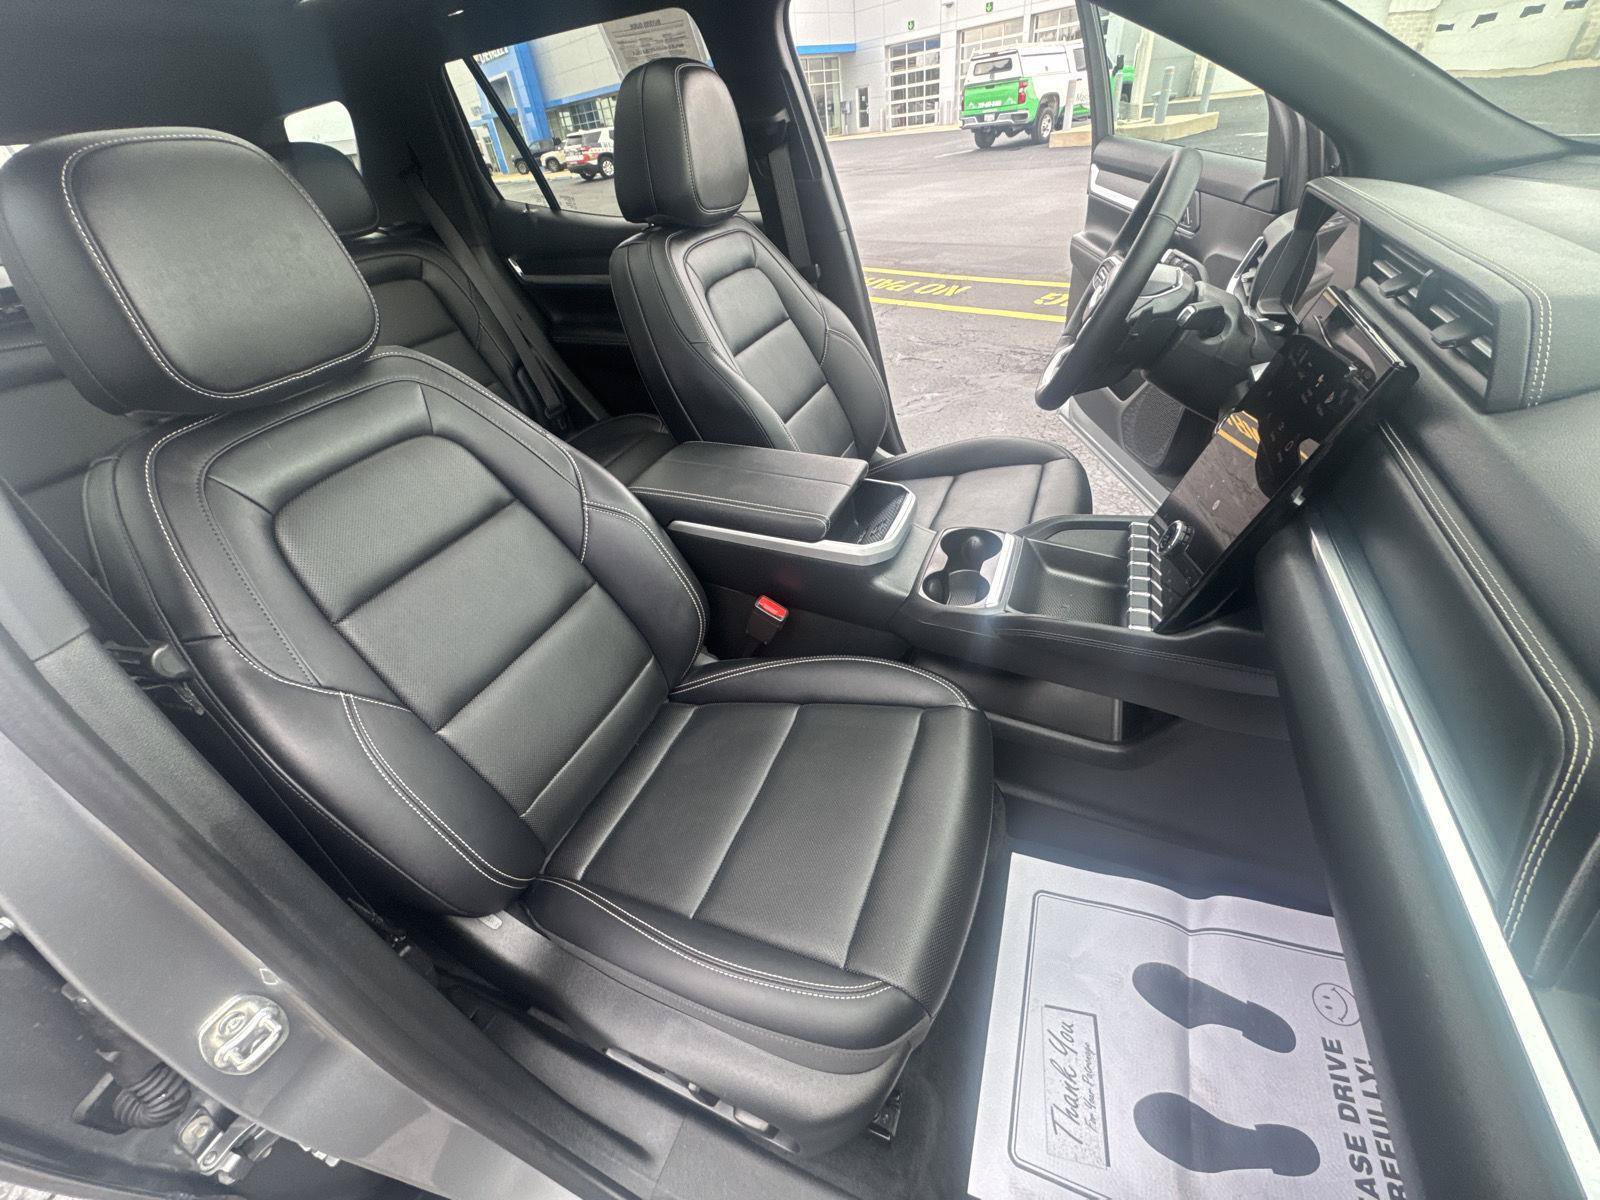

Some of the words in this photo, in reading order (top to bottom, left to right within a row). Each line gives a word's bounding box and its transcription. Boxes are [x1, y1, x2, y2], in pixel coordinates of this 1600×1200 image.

[914, 283, 972, 297] NO
[1047, 1021, 1078, 1056] You
[1050, 1058, 1083, 1144] Thank
[1321, 1036, 1361, 1124] DRIVE
[1343, 1132, 1380, 1200] ASE
